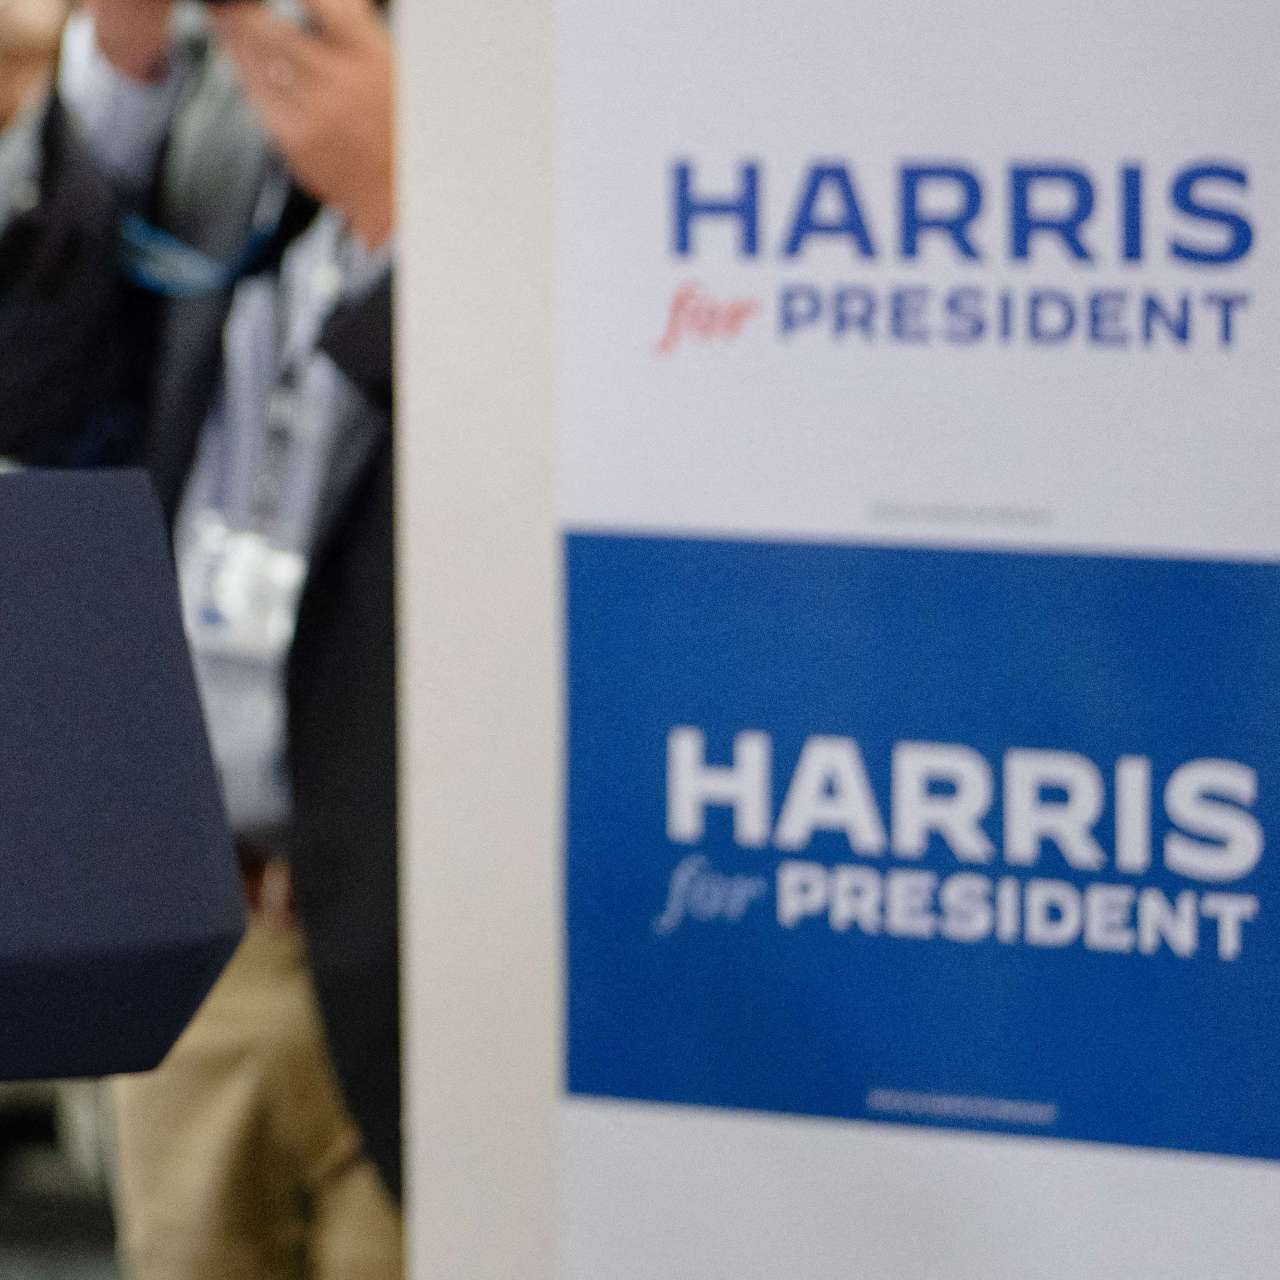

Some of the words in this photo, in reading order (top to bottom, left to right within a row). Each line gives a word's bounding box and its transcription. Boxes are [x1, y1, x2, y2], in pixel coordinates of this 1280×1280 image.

[673, 160, 1256, 269] HARRIS
[654, 280, 762, 356] for
[776, 283, 1252, 353] PRESIDENT
[668, 728, 1262, 879] HARRIS
[657, 855, 766, 931] for
[778, 862, 1257, 959] PRESIDENT
